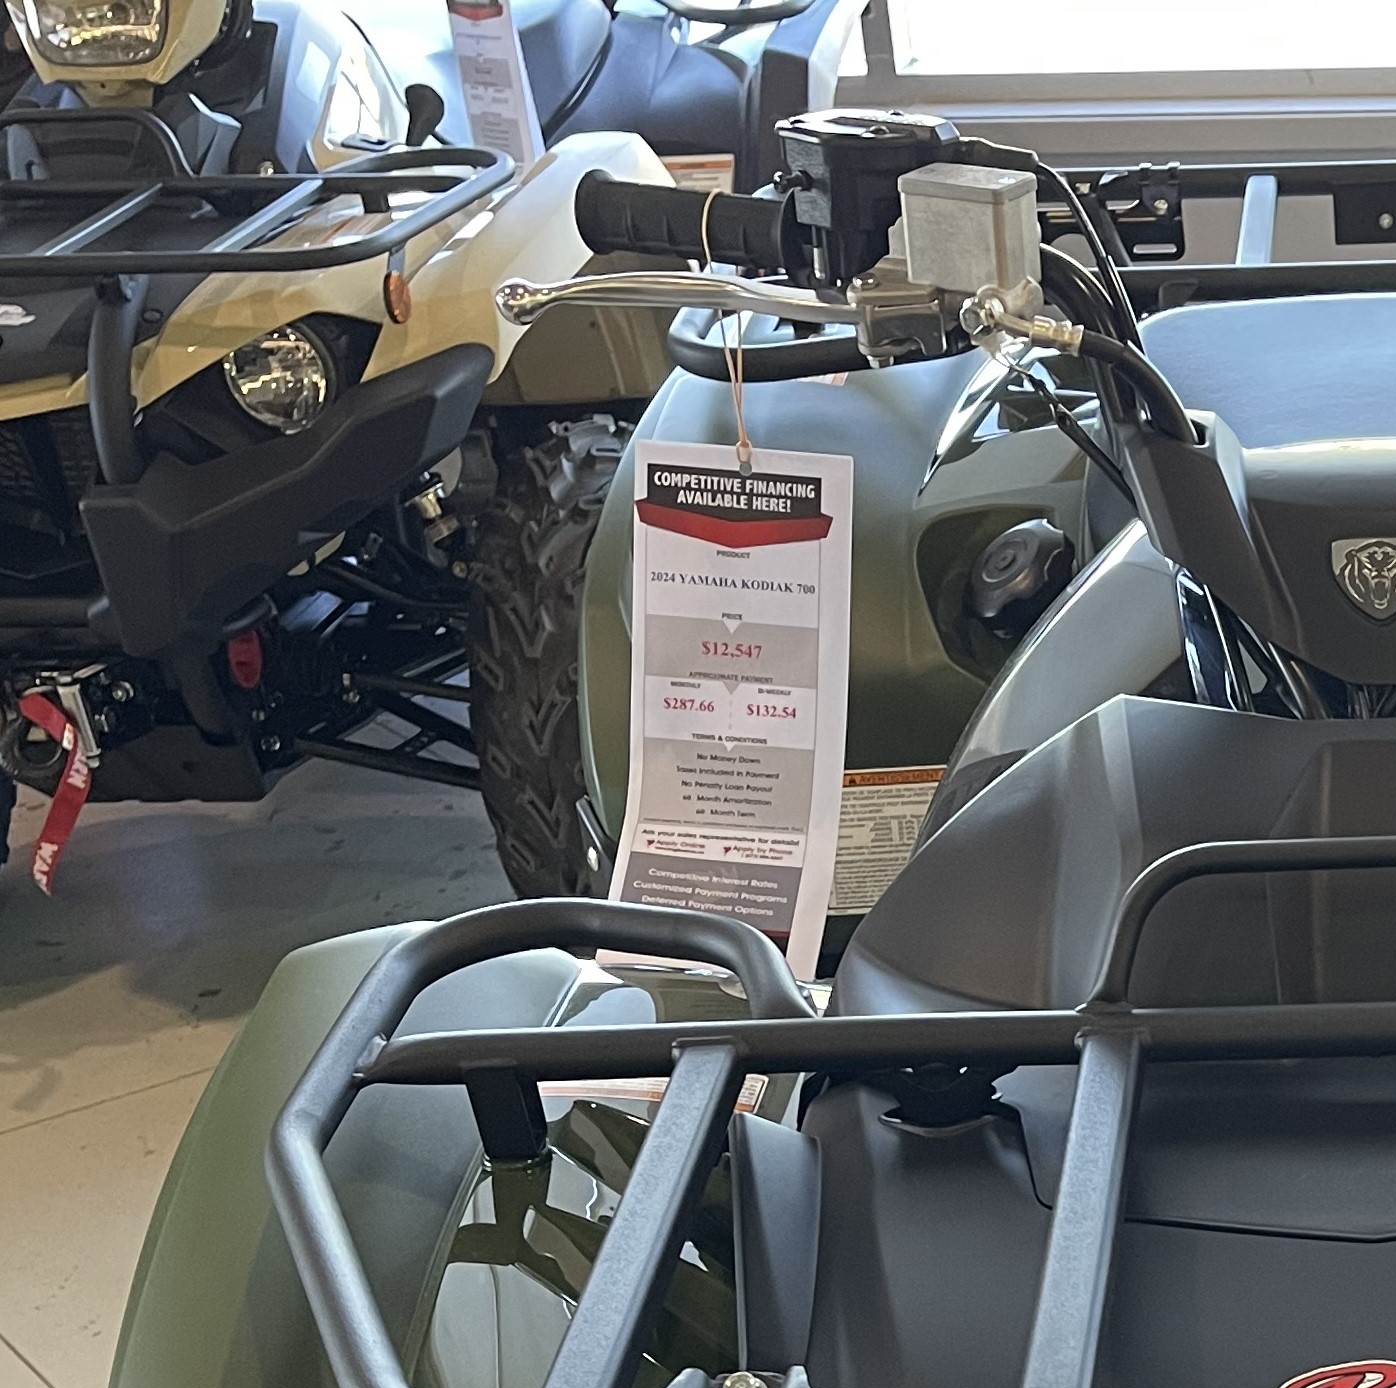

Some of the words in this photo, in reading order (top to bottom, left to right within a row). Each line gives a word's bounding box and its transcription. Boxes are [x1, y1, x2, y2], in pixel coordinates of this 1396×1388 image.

[653, 471, 742, 493] COMPETITIVE
[745, 479, 815, 499] FINANCING
[677, 490, 749, 510] AVAILABLE
[752, 497, 791, 513] HERE!
[716, 550, 751, 559] PRODUCT
[650, 571, 676, 584] 2024
[679, 573, 738, 589] YAMAHA
[741, 578, 794, 594] KODIAK
[797, 583, 816, 595] 700
[721, 612, 743, 621] PRICE
[701, 641, 762, 660] $12,547
[688, 671, 739, 682] APPROXIMATE
[741, 675, 773, 684] PAYMENT
[670, 680, 701, 689] MONTHLY
[663, 697, 715, 713] $287.66
[746, 703, 797, 719] $132.54
[691, 733, 716, 741] TERMS
[717, 734, 723, 742] &
[725, 735, 768, 745] CONDITIONS
[696, 753, 708, 761] No
[710, 754, 737, 764] Money
[739, 756, 761, 764] Down
[699, 767, 735, 777] Included
[745, 771, 780, 780] Payment
[694, 780, 723, 790] Penalty
[724, 783, 744, 791] Loan
[745, 784, 773, 793] Payout
[697, 795, 722, 803] Month
[723, 797, 773, 806] Amortization
[710, 808, 736, 816] Month
[737, 810, 756, 818] Term
[657, 830, 675, 838] your
[757, 837, 769, 845] for
[769, 847, 793, 855] Phone
[648, 867, 710, 882] Competitive
[712, 875, 749, 887] Interest
[750, 879, 778, 889] Rates
[633, 880, 693, 894] Customized
[694, 887, 739, 900] Payment
[741, 892, 788, 904] Programs
[641, 894, 686, 907] Deferred
[688, 900, 733, 912] Payment
[734, 905, 774, 917] Options
